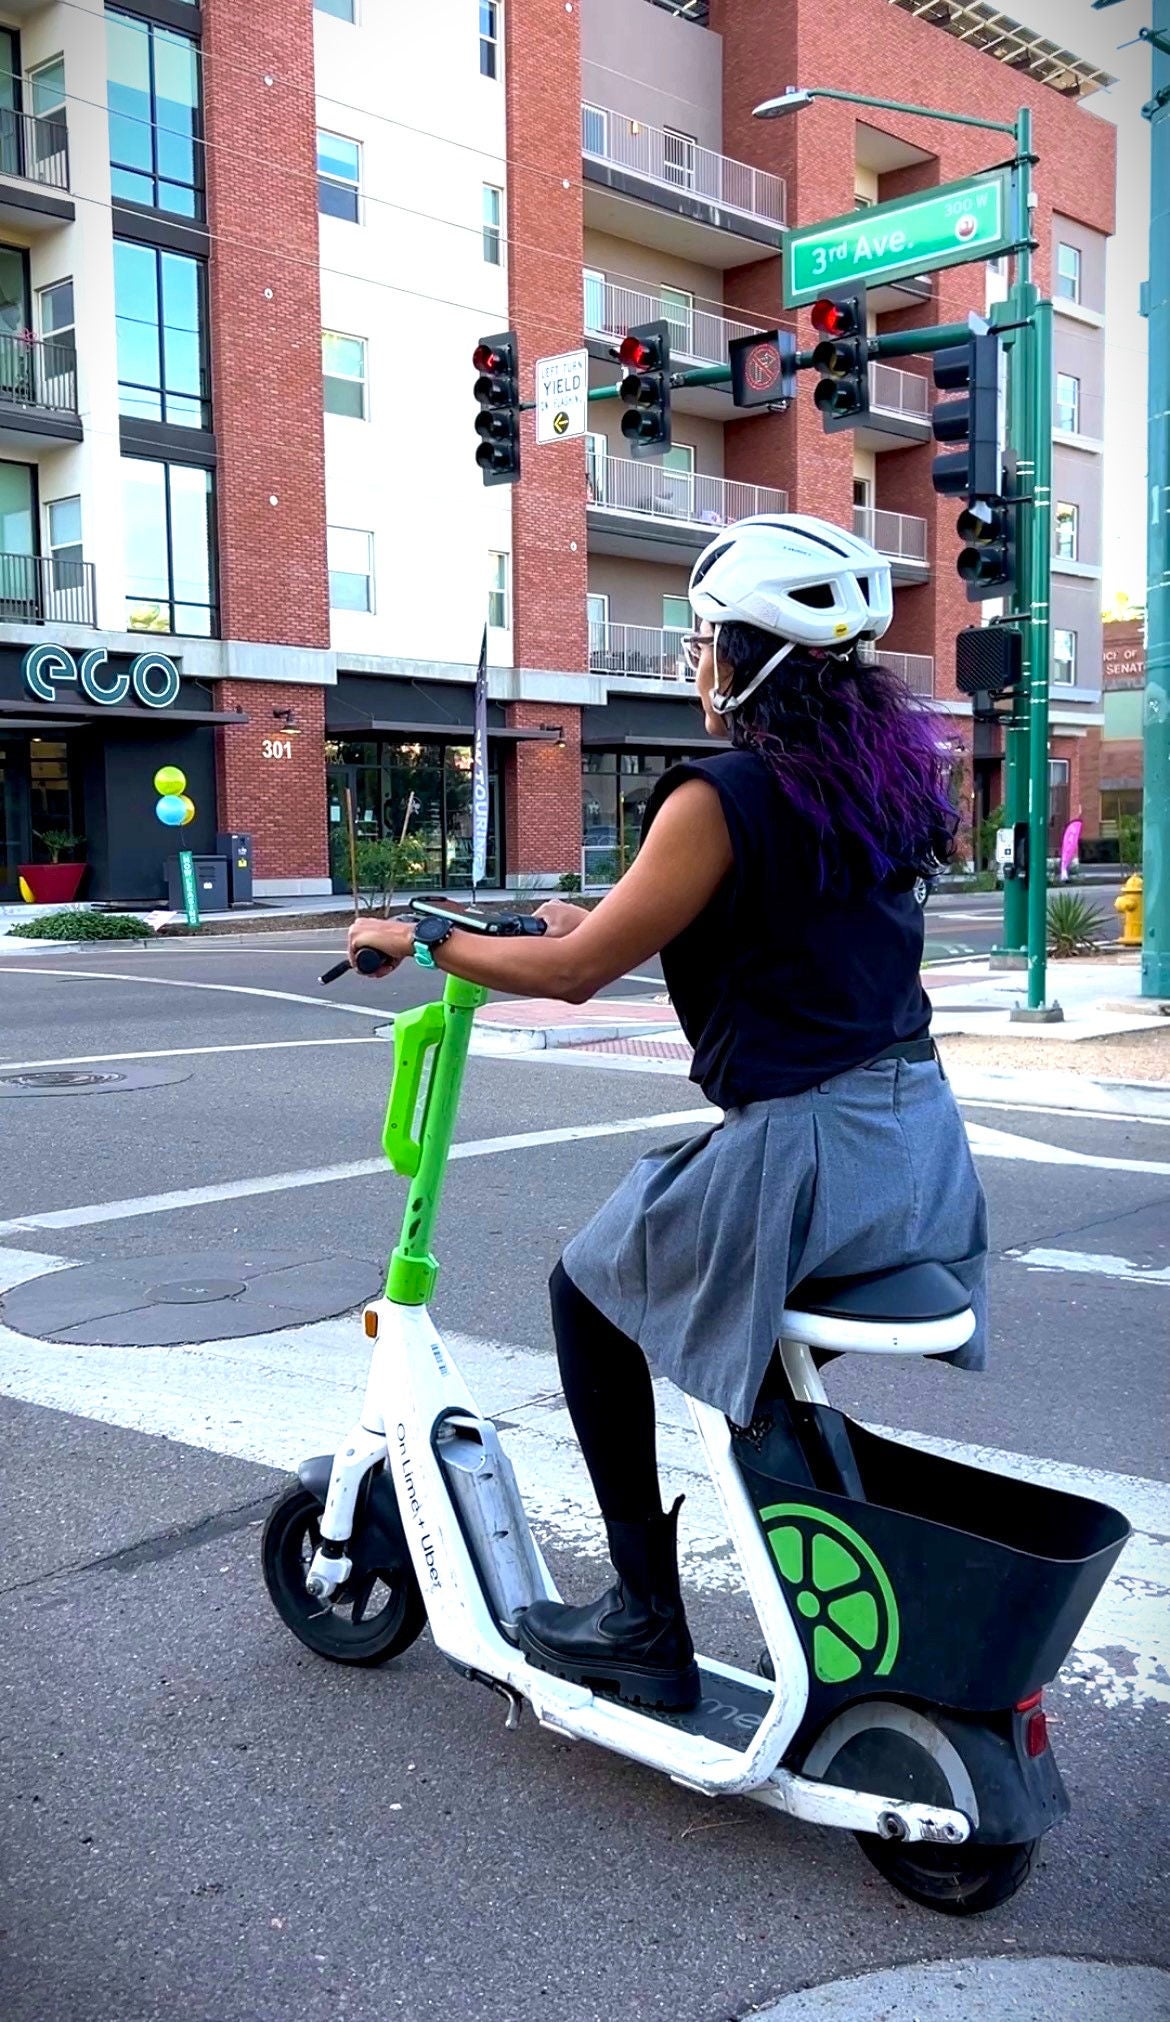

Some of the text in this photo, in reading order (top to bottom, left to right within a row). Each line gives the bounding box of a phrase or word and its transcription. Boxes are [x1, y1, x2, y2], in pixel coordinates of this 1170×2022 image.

[943, 192, 989, 218] 300 W
[811, 230, 914, 276] 3rd Ave.
[543, 375, 581, 396] YIELD
[1123, 649, 1137, 660] OF
[23, 642, 181, 709] eco
[262, 739, 292, 759] 301
[397, 1422, 408, 1455] On
[402, 1459, 422, 1514] Lime
[420, 1533, 442, 1589] Uber
